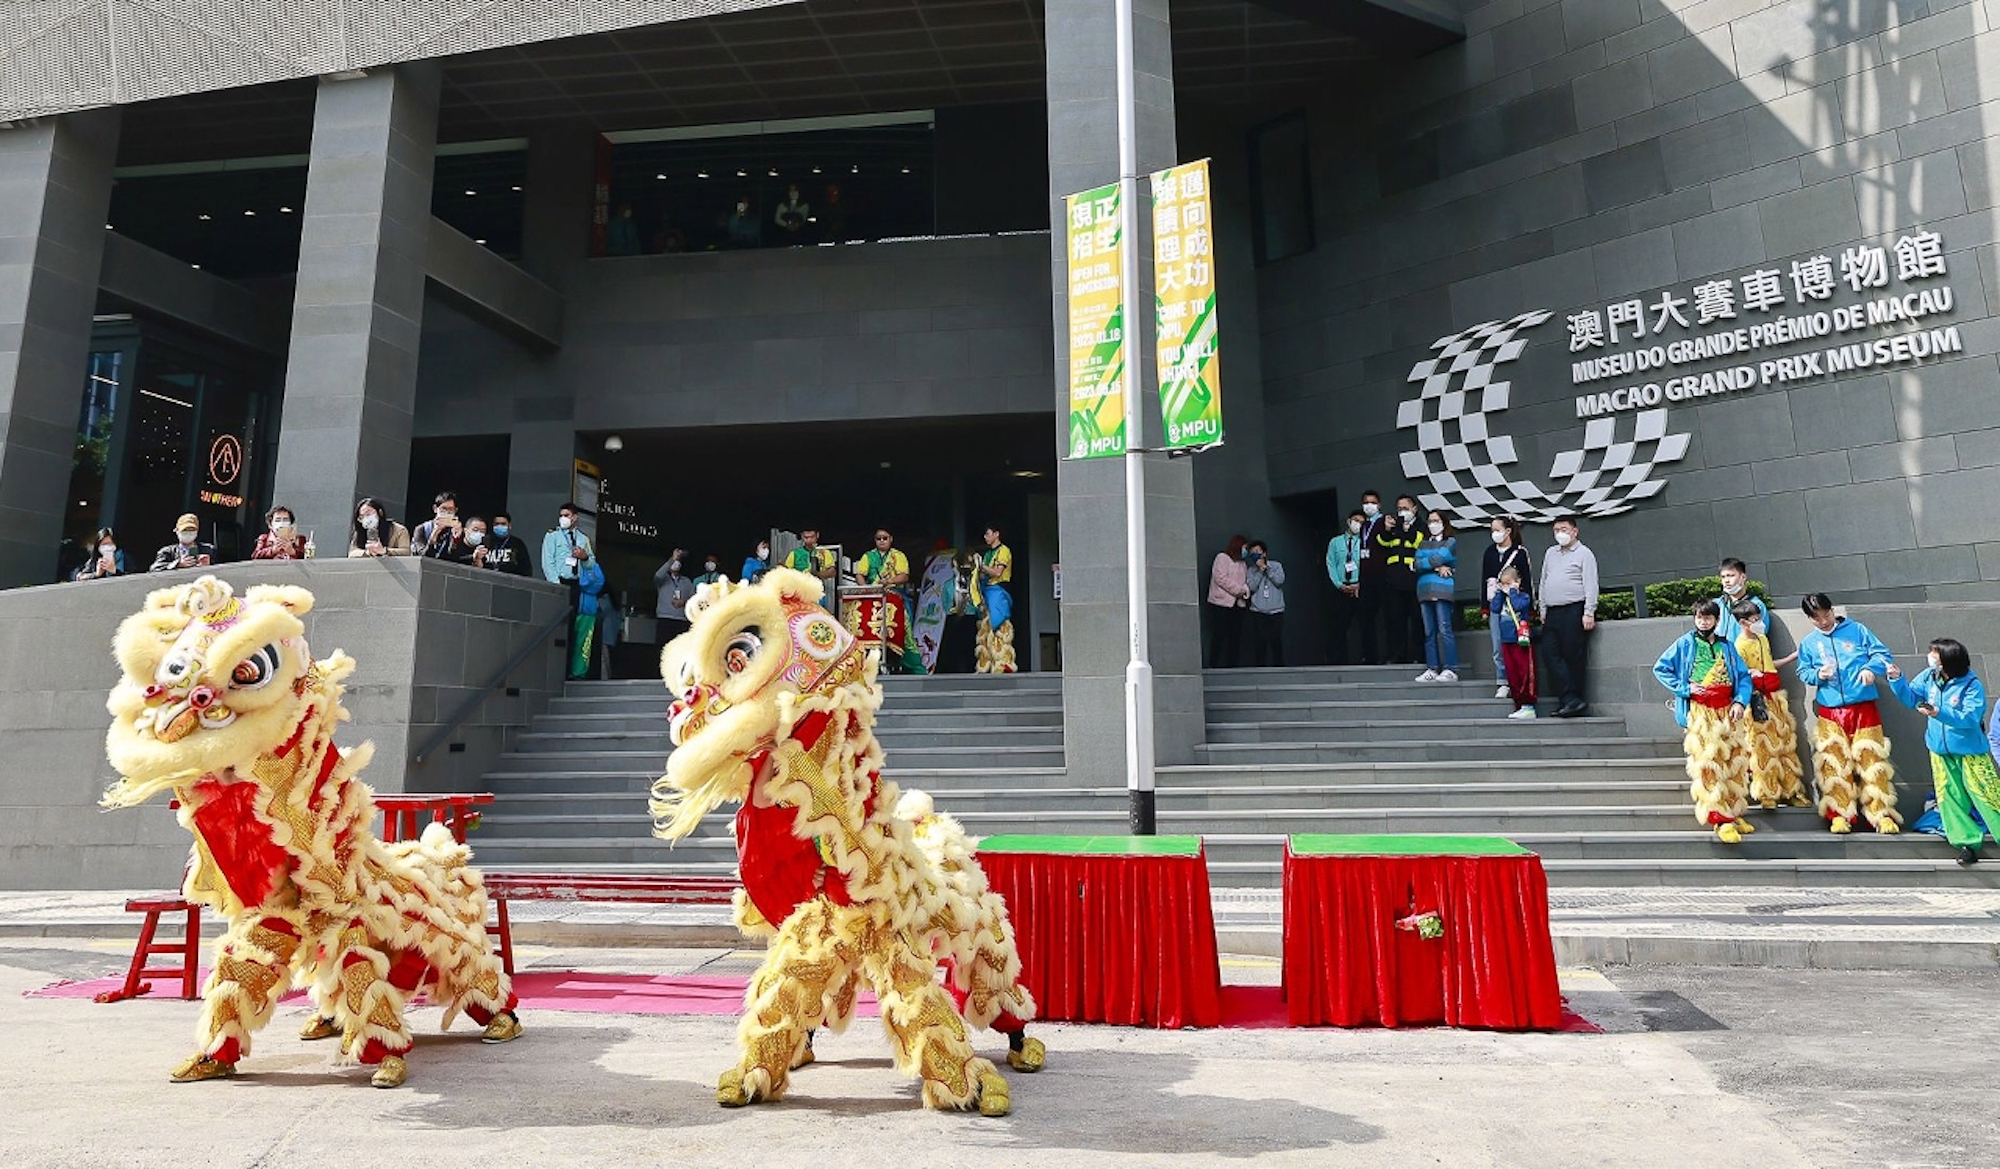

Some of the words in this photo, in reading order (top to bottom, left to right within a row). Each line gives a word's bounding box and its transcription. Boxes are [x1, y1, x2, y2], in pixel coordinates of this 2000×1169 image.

[1072, 266, 1093, 282] OPEN
[1094, 262, 1110, 276] FOR
[1072, 275, 1119, 297] ADMISSION
[1566, 231, 1947, 352] 澳門大賽車博物館
[1158, 301, 1187, 321] COME
[1190, 298, 1206, 315] TO
[1571, 351, 1636, 384] MUSEU
[1636, 346, 1667, 371] DO
[1667, 328, 1750, 365] GRANDE
[1750, 311, 1832, 348] PRÉMIO
[1833, 304, 1867, 332] DE
[1867, 286, 1954, 325] MACAU
[1160, 346, 1181, 364] YOU
[1182, 341, 1215, 361] WILL
[1575, 383, 1663, 418] MACAO
[1665, 366, 1757, 401] GRAND
[1760, 352, 1824, 384] PRIX
[1826, 326, 1963, 373] MUSEUM
[1182, 419, 1217, 438] MPU
[1091, 435, 1122, 453] MPU
